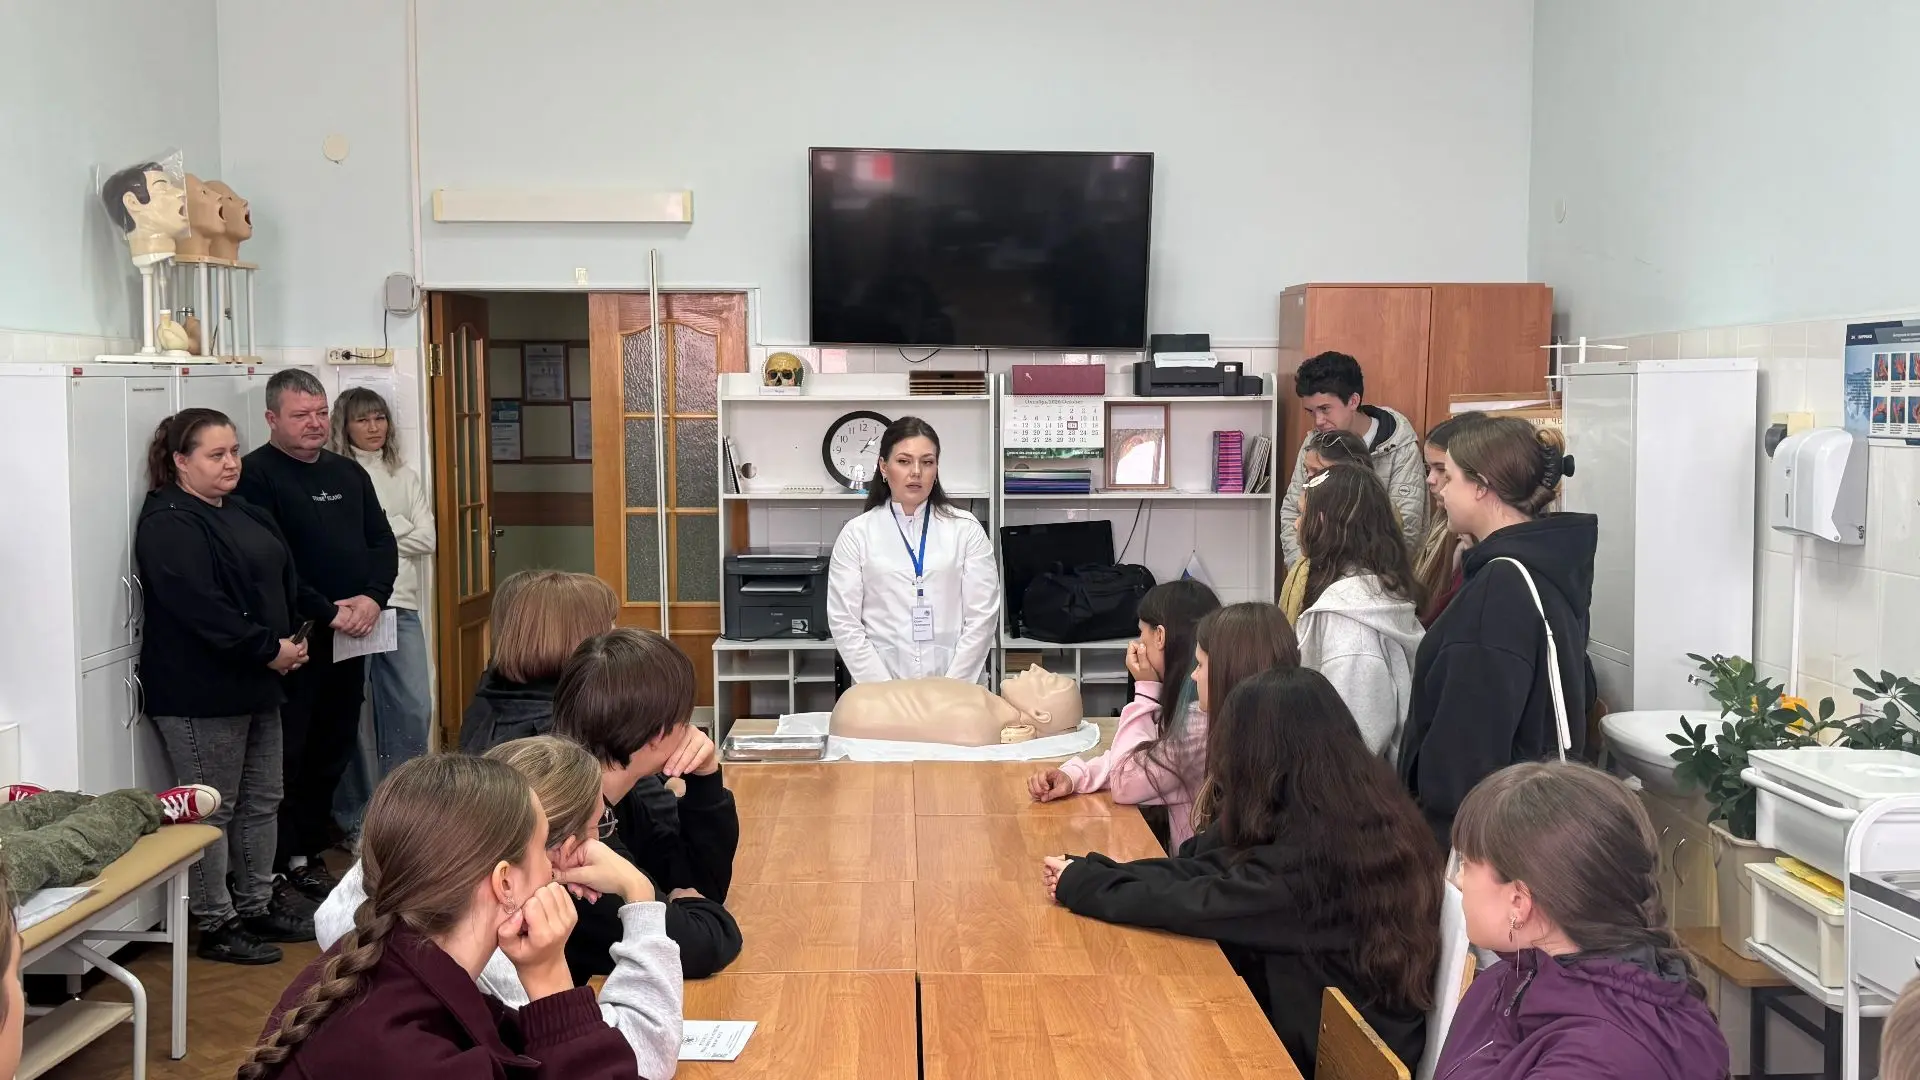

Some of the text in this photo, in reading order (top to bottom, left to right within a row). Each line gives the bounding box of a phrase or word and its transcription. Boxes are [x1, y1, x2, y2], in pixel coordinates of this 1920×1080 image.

[860, 423, 868, 431] 12
[840, 435, 849, 443] 10
[836, 446, 841, 454] 9
[840, 457, 846, 465] 8
